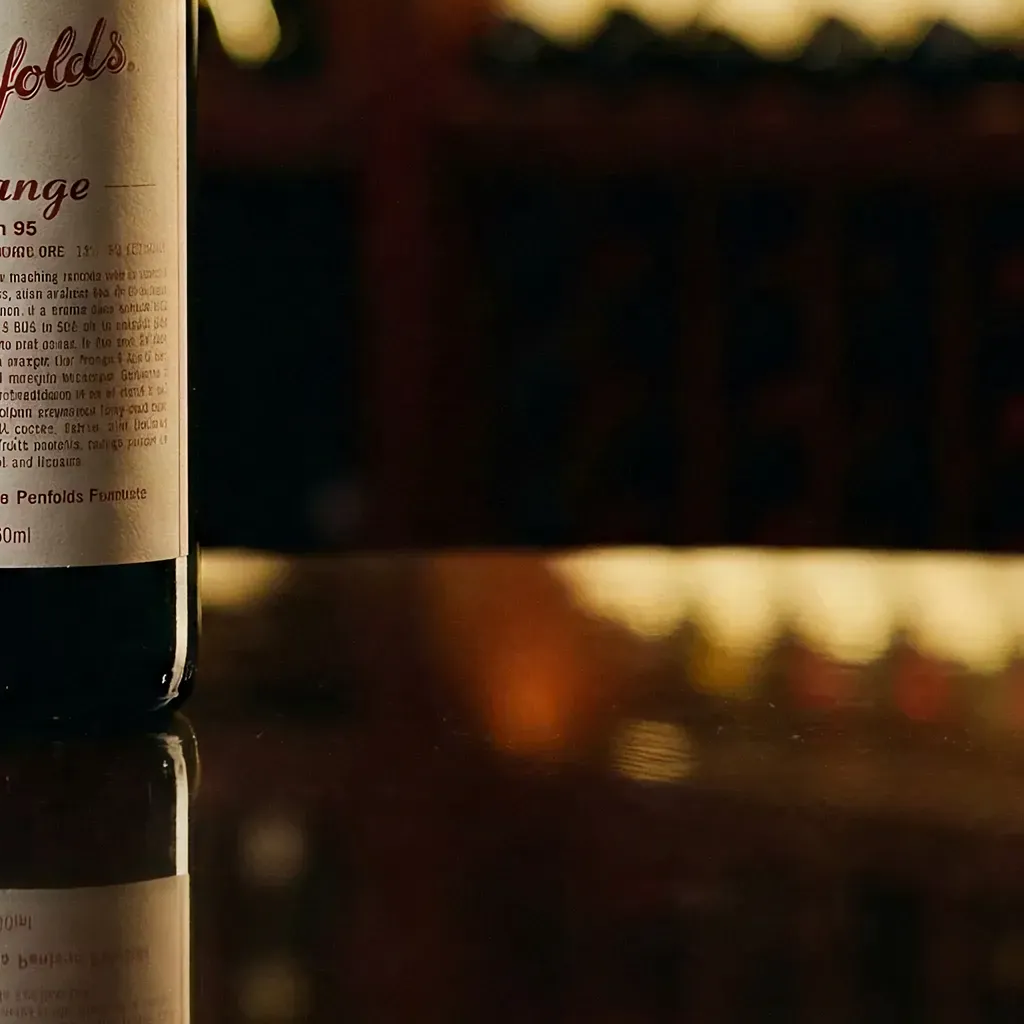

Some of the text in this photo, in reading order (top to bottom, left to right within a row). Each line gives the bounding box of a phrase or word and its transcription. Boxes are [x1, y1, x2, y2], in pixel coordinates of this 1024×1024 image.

[13, 221, 37, 236] 95
[11, 456, 33, 469] and
[17, 489, 84, 505] Penfolds
